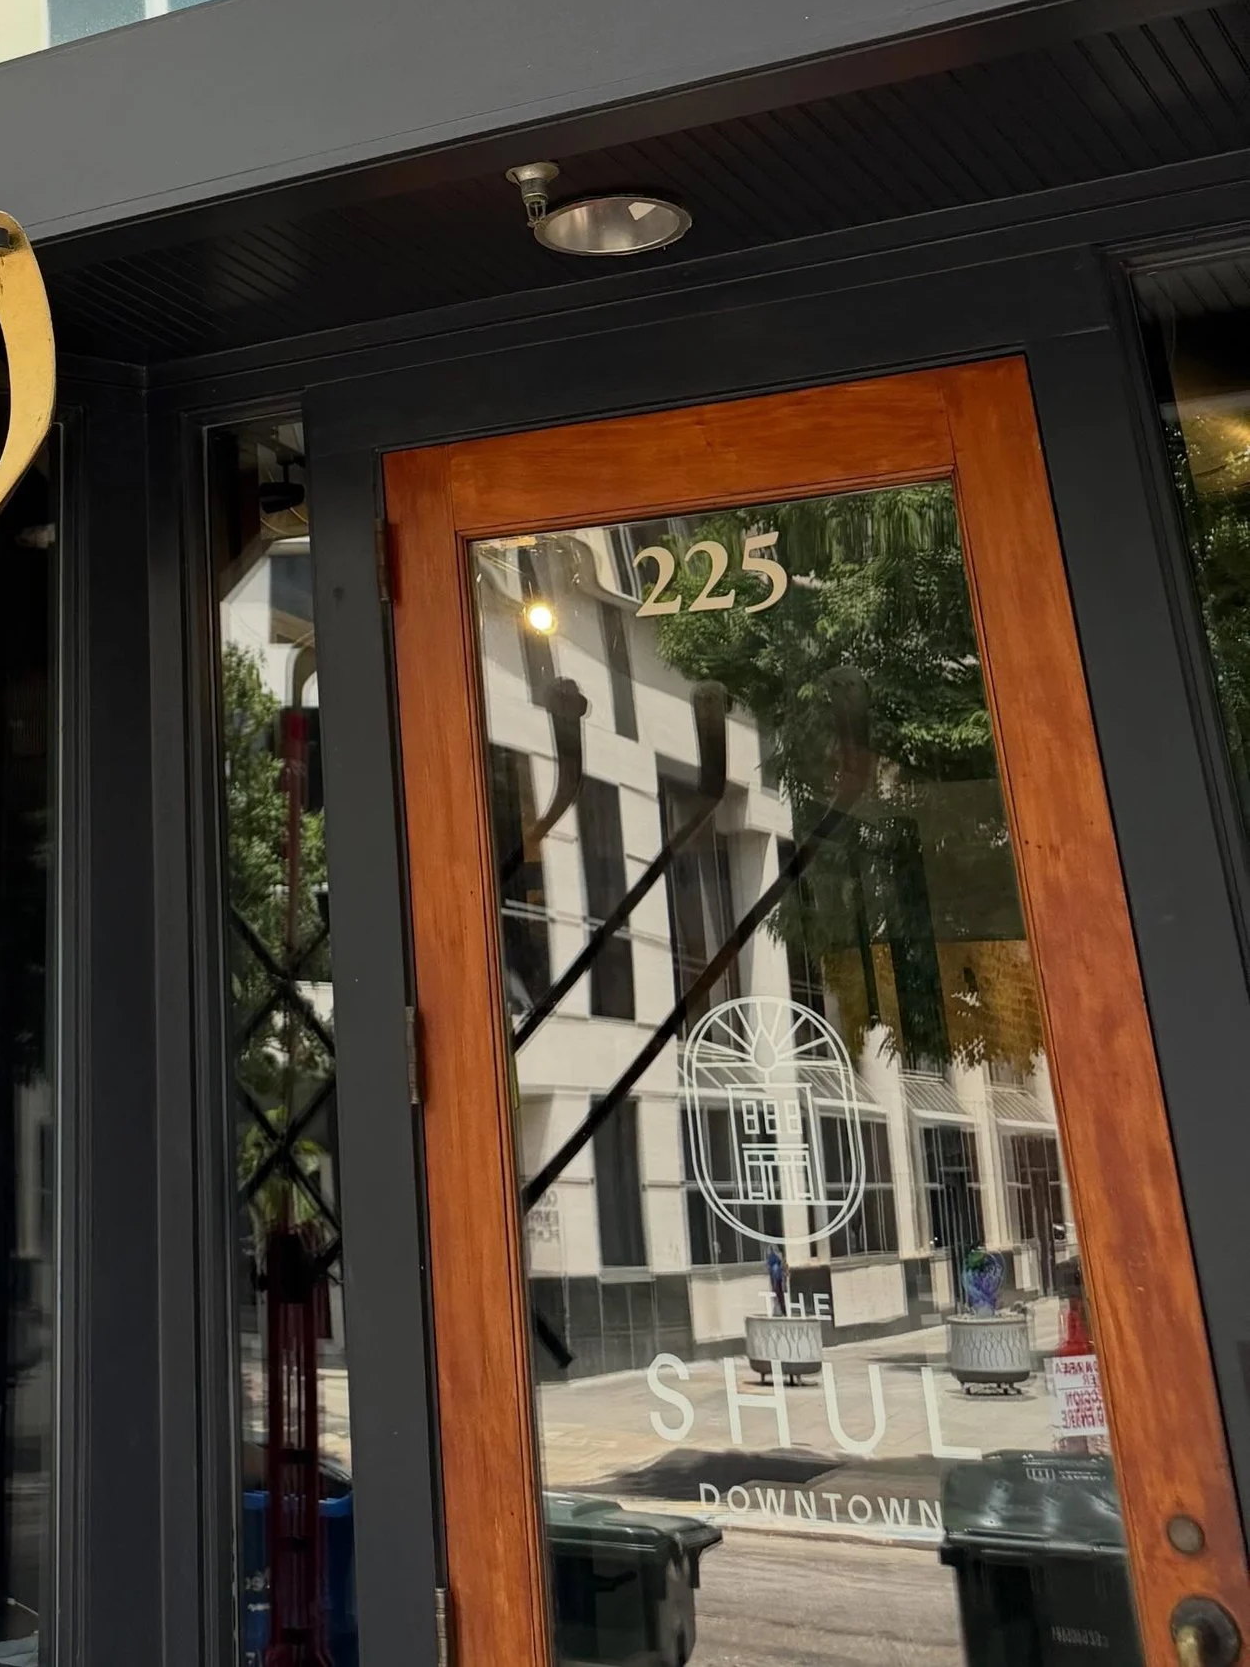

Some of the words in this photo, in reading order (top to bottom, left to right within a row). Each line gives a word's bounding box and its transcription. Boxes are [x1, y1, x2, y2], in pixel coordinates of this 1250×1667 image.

[632, 531, 789, 618] 225
[758, 1290, 833, 1322] THE
[647, 1352, 982, 1461] SHUL
[699, 1482, 944, 1531] DOWNTOWN
